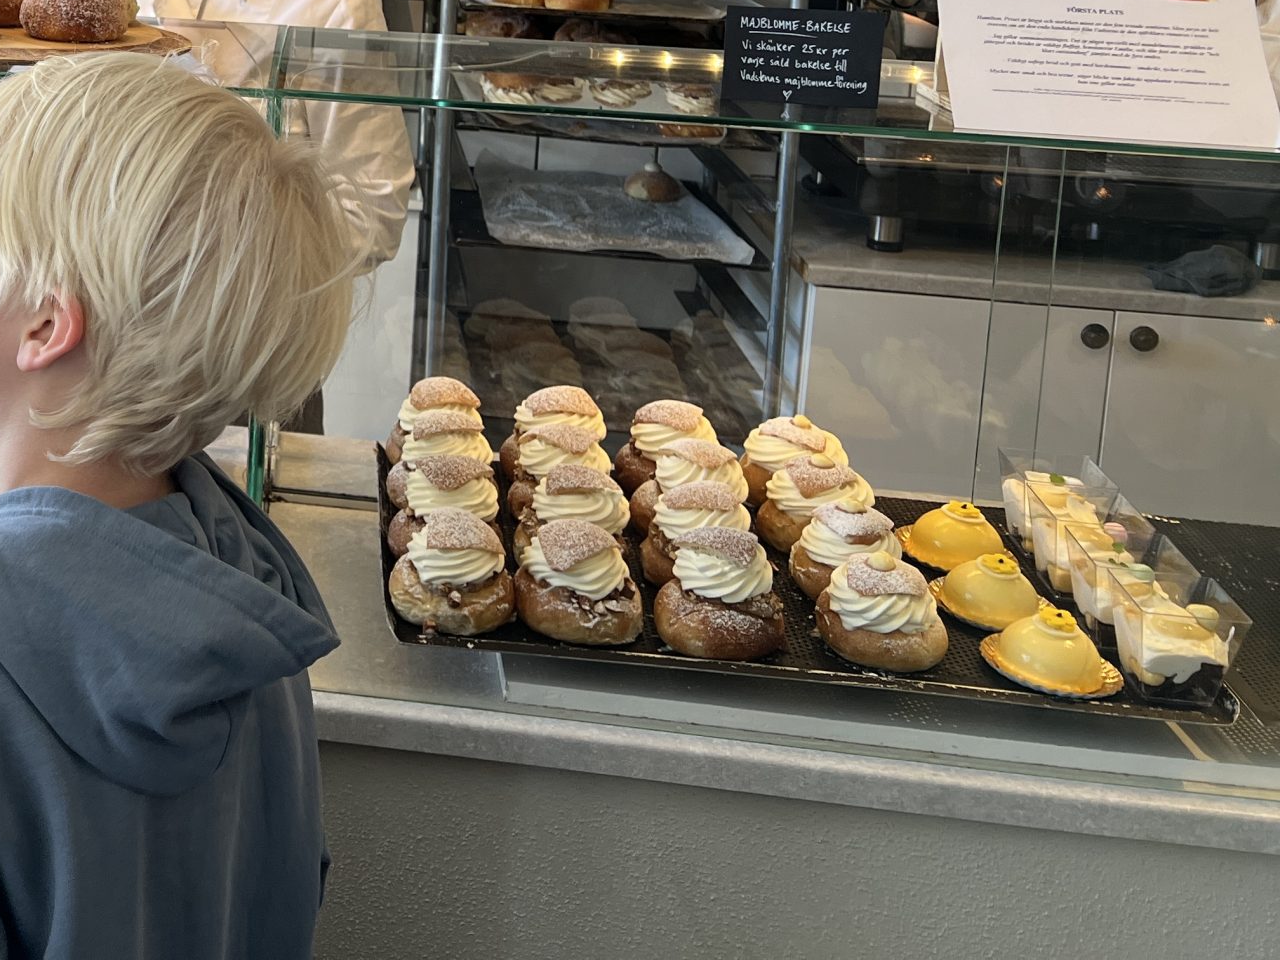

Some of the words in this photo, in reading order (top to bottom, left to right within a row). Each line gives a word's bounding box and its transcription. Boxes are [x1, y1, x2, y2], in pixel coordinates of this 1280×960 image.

[742, 39, 752, 50] Vi
[756, 40, 795, 52] skänker
[832, 48, 850, 58] per
[741, 56, 765, 68] varje
[770, 55, 790, 68] såld
[795, 59, 832, 70] bakelse
[834, 59, 848, 73] till
